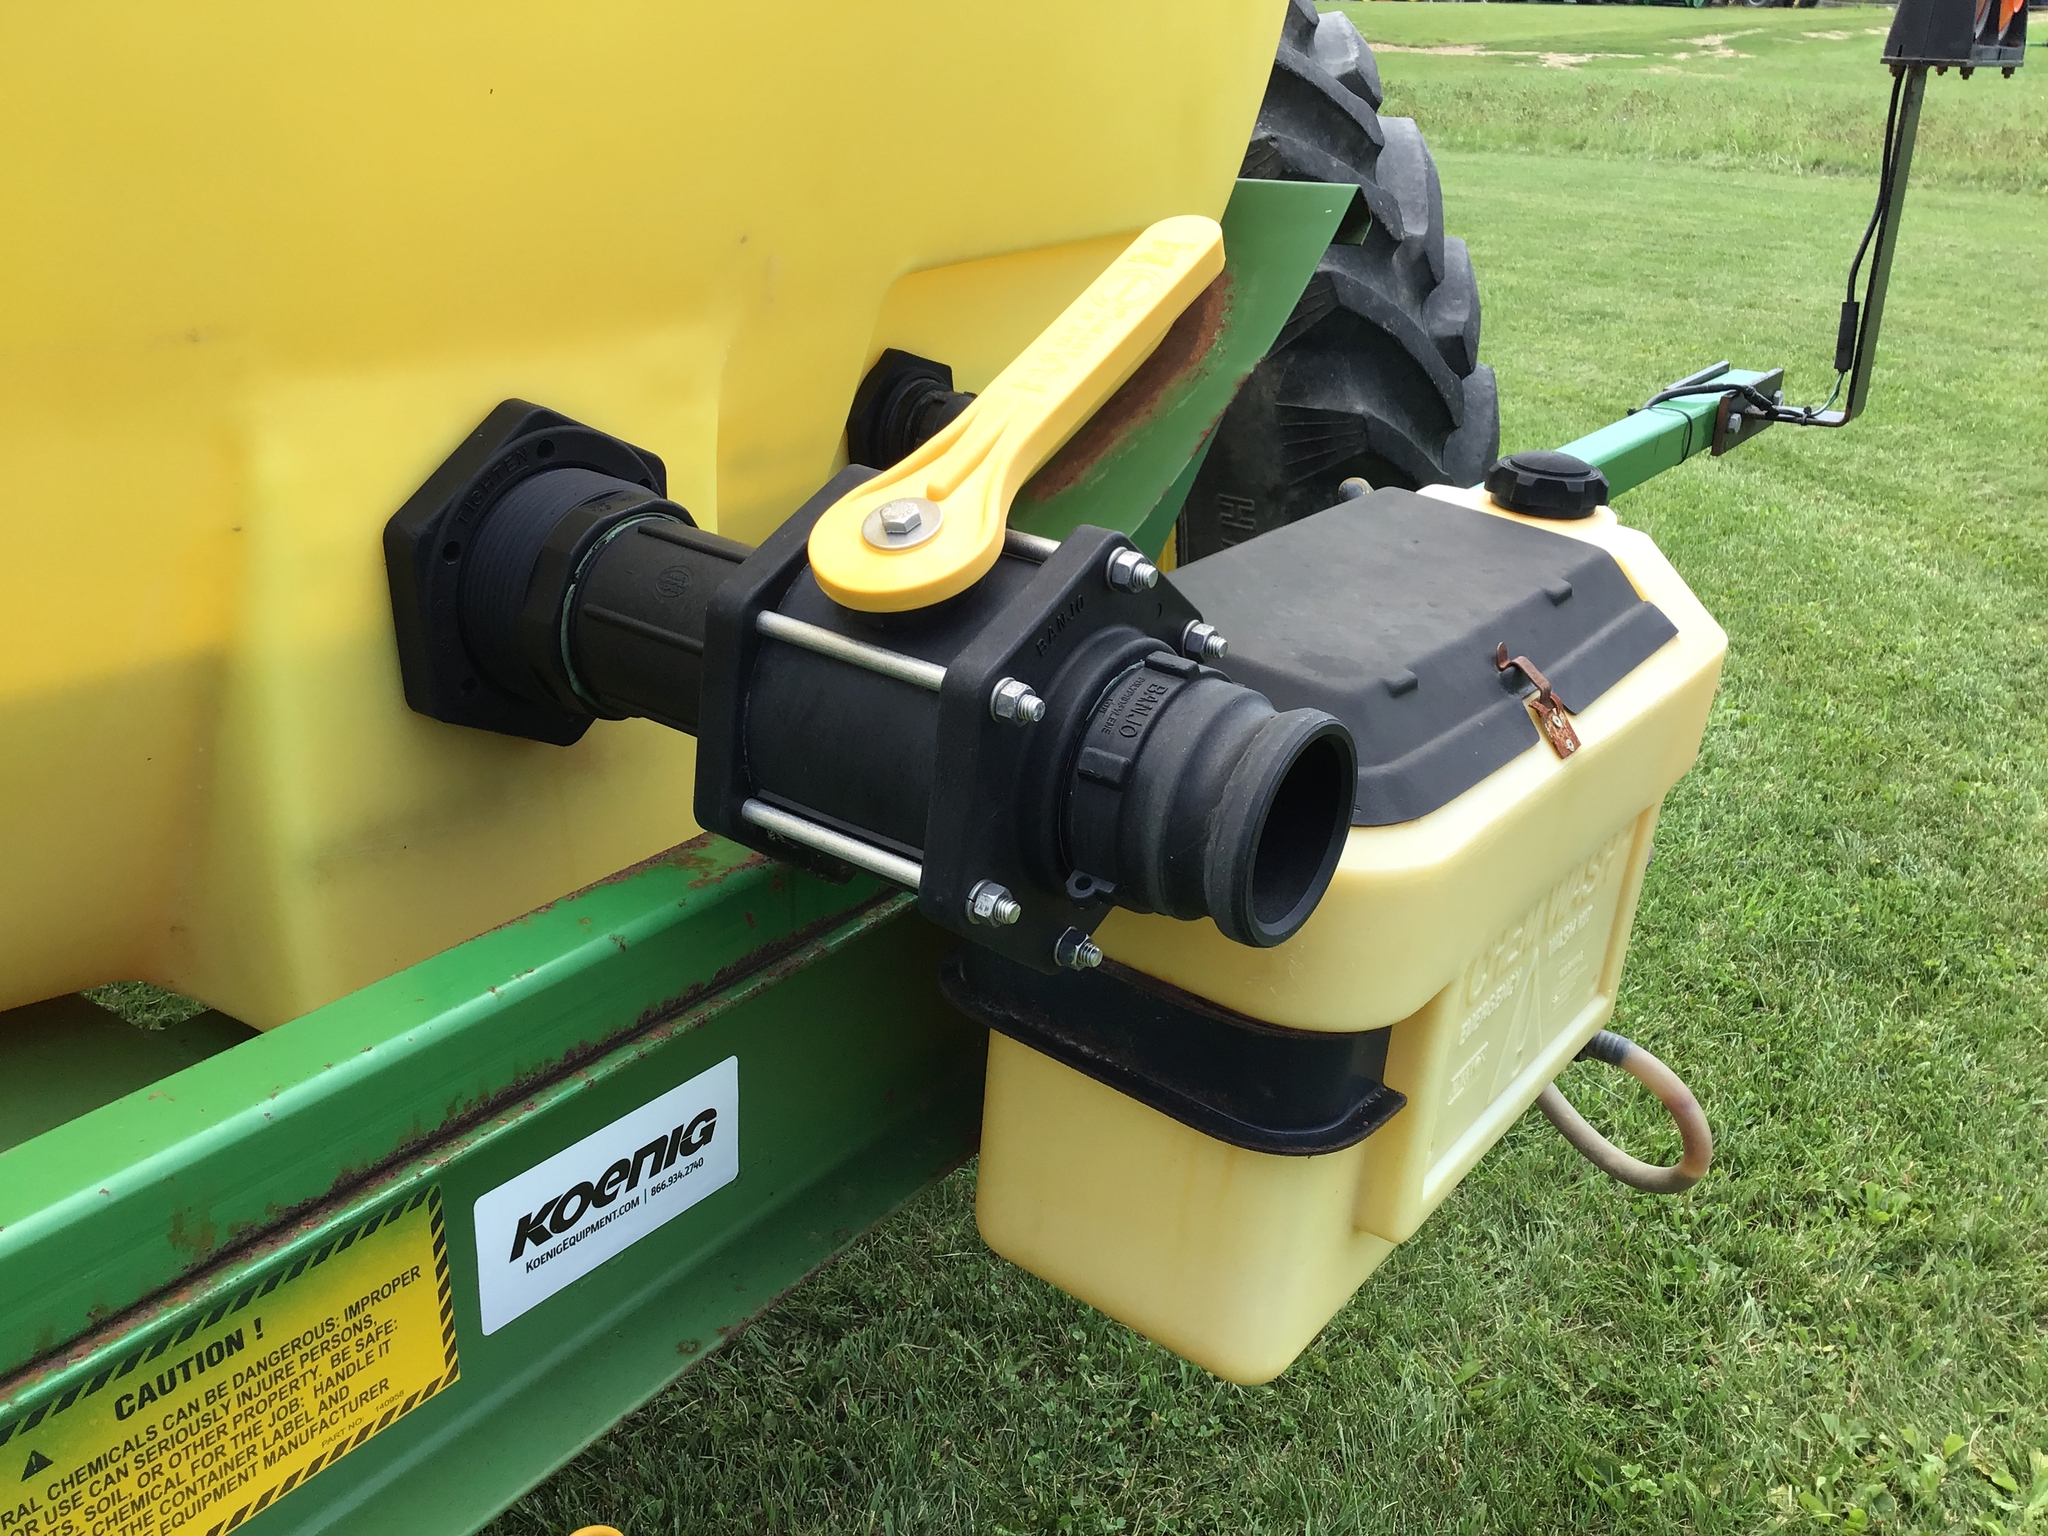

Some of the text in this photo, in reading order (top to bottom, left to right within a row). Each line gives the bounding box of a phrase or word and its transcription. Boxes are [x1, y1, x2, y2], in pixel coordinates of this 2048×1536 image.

[1035, 594, 1084, 657] BANJO
[1118, 683, 1168, 739] BANJO
[650, 1156, 704, 1197] 866.934.2740
[43, 1490, 85, 1525] USE
[88, 1462, 130, 1498] CAN
[133, 1399, 231, 1471] SERIOUSLY
[236, 1368, 296, 1404] INJURE
[300, 1313, 378, 1370] PERSONS,
[47, 1424, 158, 1501] CHEMICALS
[162, 1398, 201, 1431] CAN
[204, 1380, 228, 1406] BE
[232, 1316, 341, 1390] DANGEROUS:
[343, 1265, 421, 1323] IMPROPER
[84, 1319, 398, 1523] SOIL, OR OTHER PROPERTY. BE SAFE:
[92, 1472, 187, 1536] CHEMICAL
[190, 1444, 227, 1475] FOR
[230, 1417, 265, 1450] THE
[267, 1396, 305, 1428] JOB:
[313, 1352, 375, 1399] HANDLE
[378, 1338, 392, 1359] IT
[114, 1327, 245, 1421] CAUTION
[321, 1429, 346, 1449] PART
[159, 1443, 258, 1516] CONTAINER
[262, 1412, 315, 1451] LABEL
[318, 1385, 350, 1417] AND
[160, 1377, 390, 1536] EQUIPMENT MANUFACTURER
